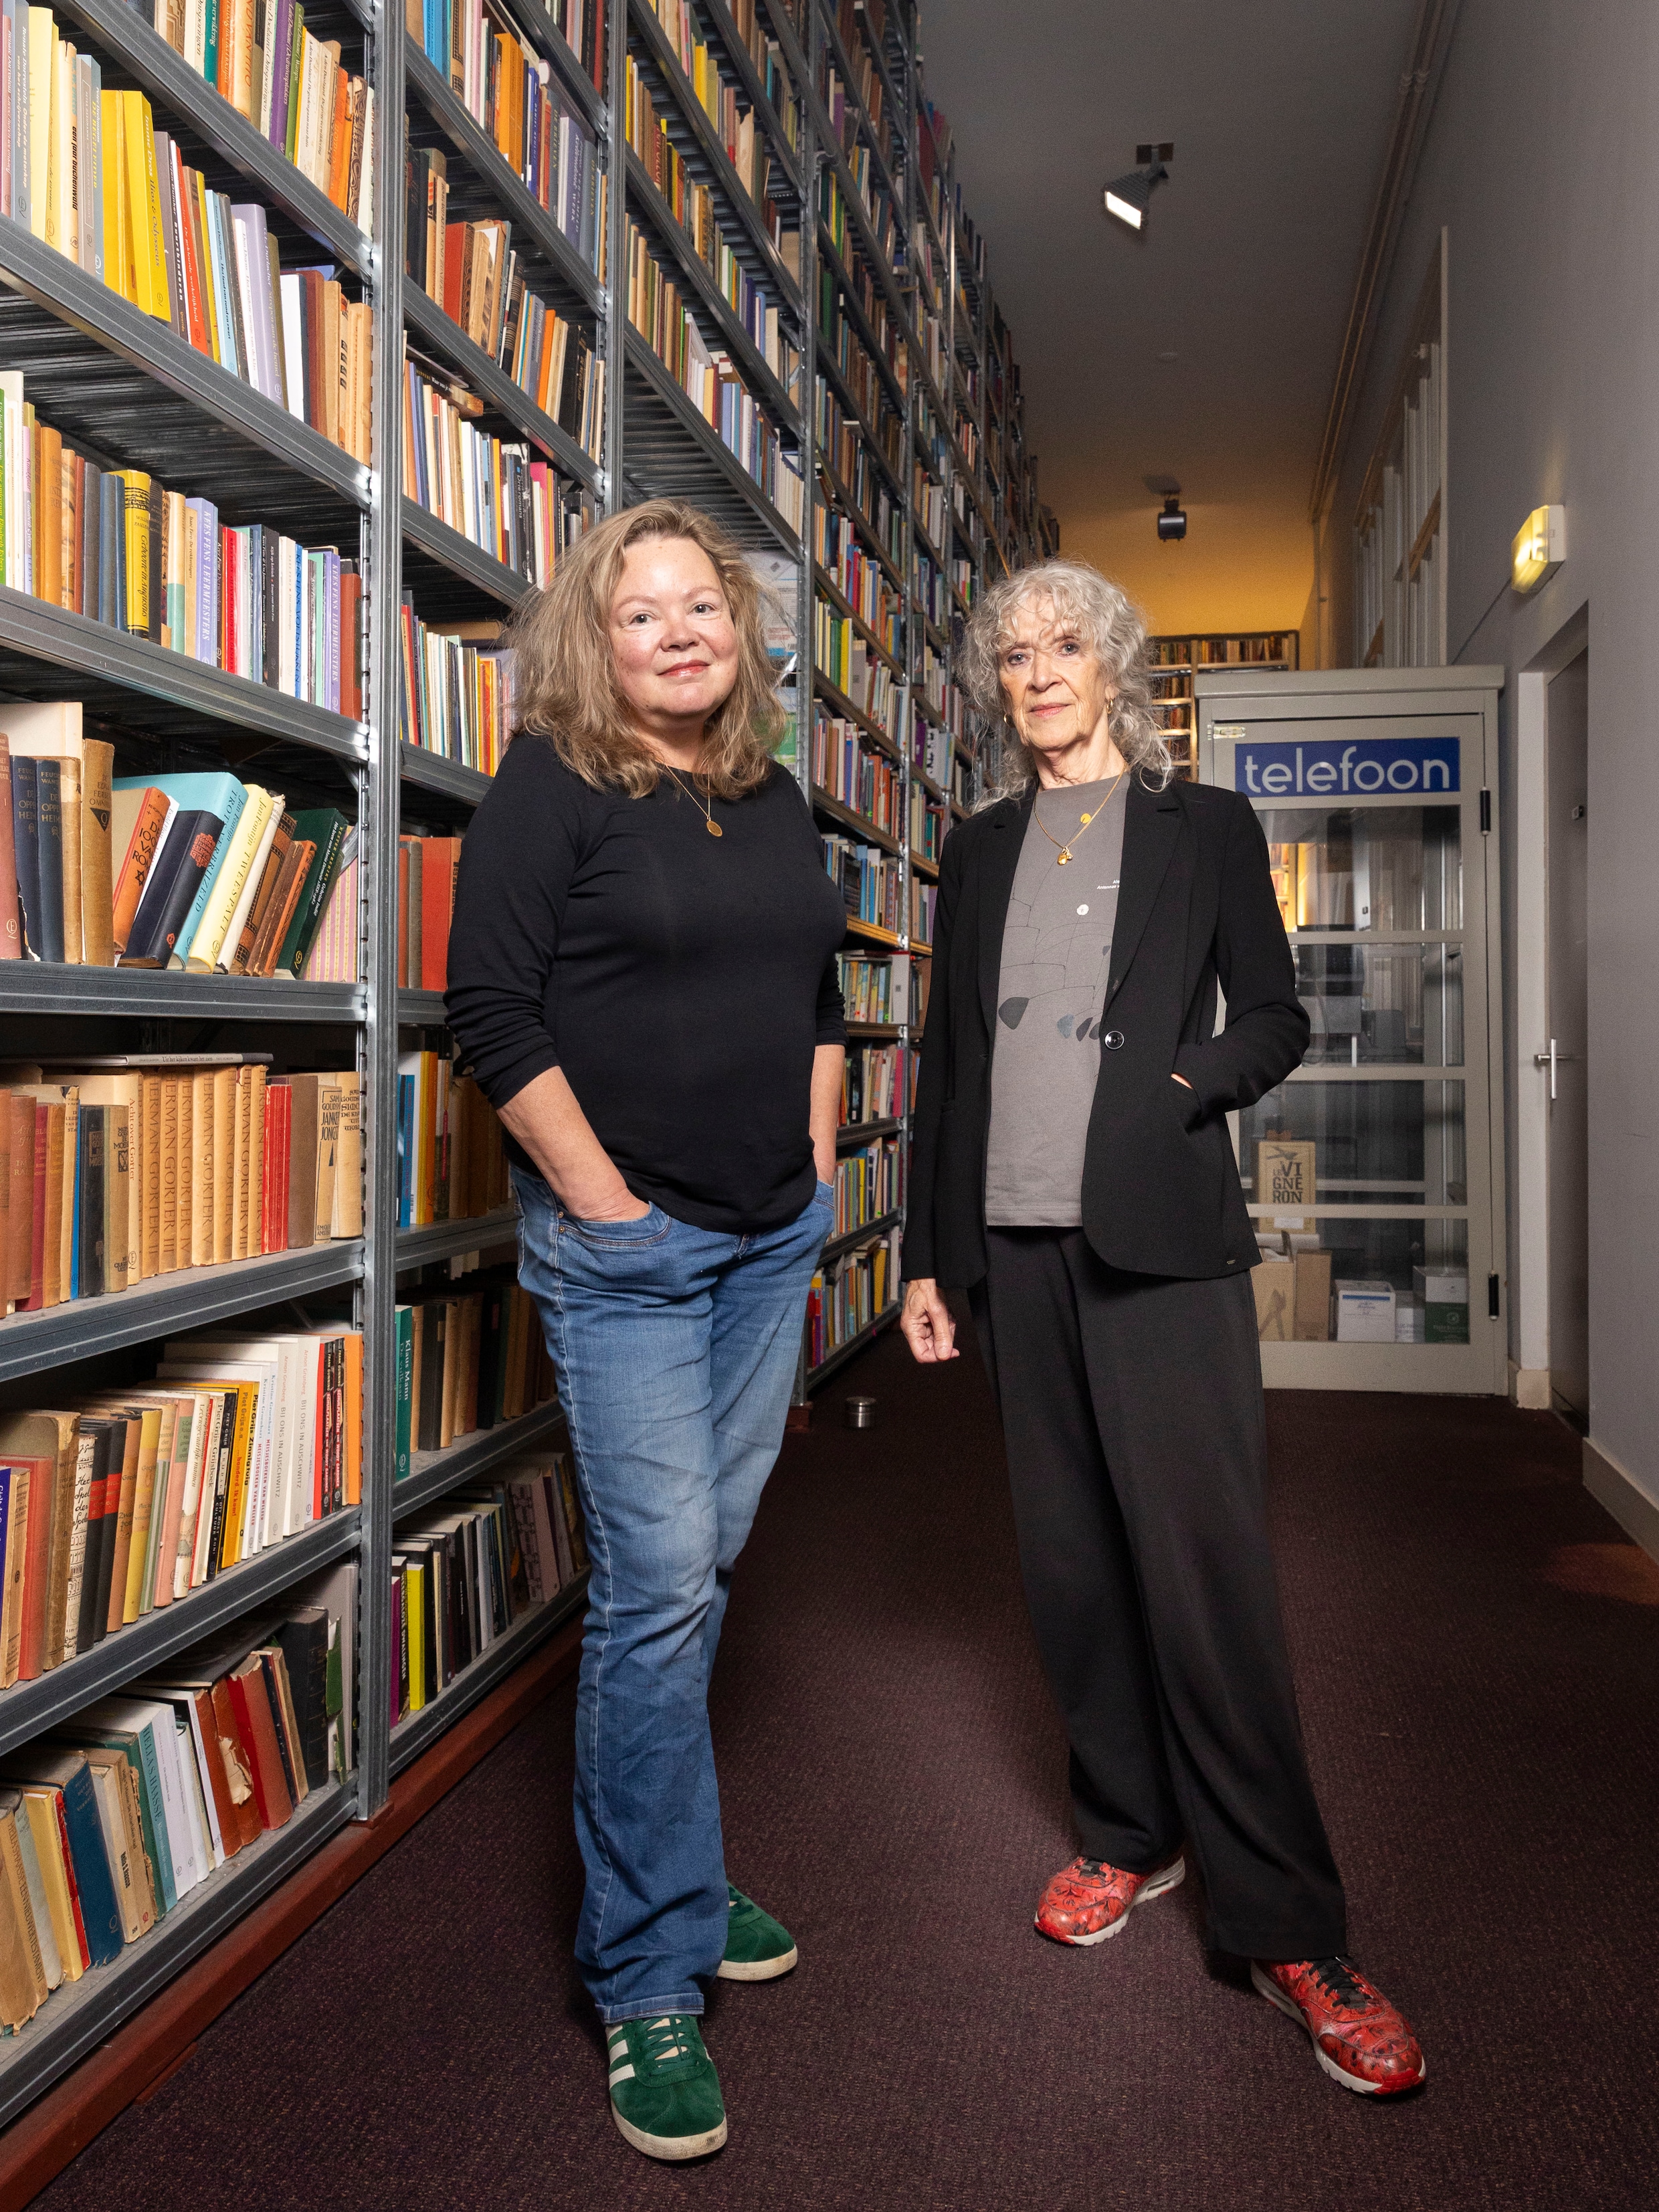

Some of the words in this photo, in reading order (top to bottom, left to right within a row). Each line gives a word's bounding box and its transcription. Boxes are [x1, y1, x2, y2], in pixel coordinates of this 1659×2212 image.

[263, 54, 271, 112] Ontsporingen
[553, 109, 558, 124] DE
[23, 134, 27, 146] de
[151, 215, 161, 267] Odysseus
[174, 221, 183, 301] Buurtkinderen
[264, 245, 272, 288] Durlacher
[189, 276, 199, 322] werkelijkheid
[140, 535, 149, 571] Geboorte
[203, 536, 211, 562] FENS
[141, 572, 149, 581] in
[137, 581, 149, 617] Augustus
[202, 565, 211, 641] LEERMEESTERS
[1245, 746, 1450, 793] telefoon
[235, 795, 245, 812] Jan
[257, 797, 268, 813] Jan
[225, 812, 239, 842] Fontijn
[246, 813, 262, 847] Fontijn
[332, 825, 344, 852] KESTER
[194, 829, 227, 913] VERBRIJZELD
[318, 862, 328, 882] Dermoût
[323, 852, 336, 882] FRERIKS
[219, 850, 252, 937] TWEESPALT
[310, 880, 322, 906] 1888-1962
[313, 902, 322, 916] Indië
[318, 882, 326, 902] Geheim
[149, 1074, 160, 1154] HERMAN
[165, 1076, 176, 1150] HERMAN
[181, 1078, 192, 1150] HERMAN
[203, 1072, 214, 1146] HERMAN
[227, 1070, 235, 1146] HERMAN
[241, 1068, 252, 1143] HERMAN
[148, 1161, 160, 1238] GORTER
[163, 1156, 176, 1232] GORTER
[181, 1156, 193, 1229] GORTER
[202, 1153, 213, 1226] GORTER
[225, 1152, 234, 1225] GORTER
[239, 1150, 251, 1221] GORTER
[1272, 1177, 1303, 1190] GNE
[1272, 1191, 1302, 1203] RON
[163, 1238, 175, 1253] III
[215, 1404, 223, 1421] Piet
[249, 1413, 257, 1434] Grijs
[258, 1406, 266, 1439] Groenhart
[194, 1404, 205, 1461] Levensgevaarlijke
[213, 1422, 221, 1443] Grijs
[278, 1440, 284, 1449] IN
[299, 1433, 304, 1441] IN
[208, 1447, 218, 1488] Grijsboek
[246, 1437, 254, 1467] Zinnig
[254, 1443, 262, 1488] MEISJESBOEKEN
[262, 1439, 271, 1484] MEISJESBOEKEN
[76, 1473, 90, 1486] Het
[191, 1462, 199, 1488] mannen
[275, 1451, 283, 1498] AUSCHWITZ
[142, 1726, 155, 1767] HELLA
[150, 1775, 163, 1822] HAASSE
[7, 1820, 18, 1847] HELLA
[120, 1851, 128, 1864] Hella
[123, 1869, 131, 1889] Haasse
